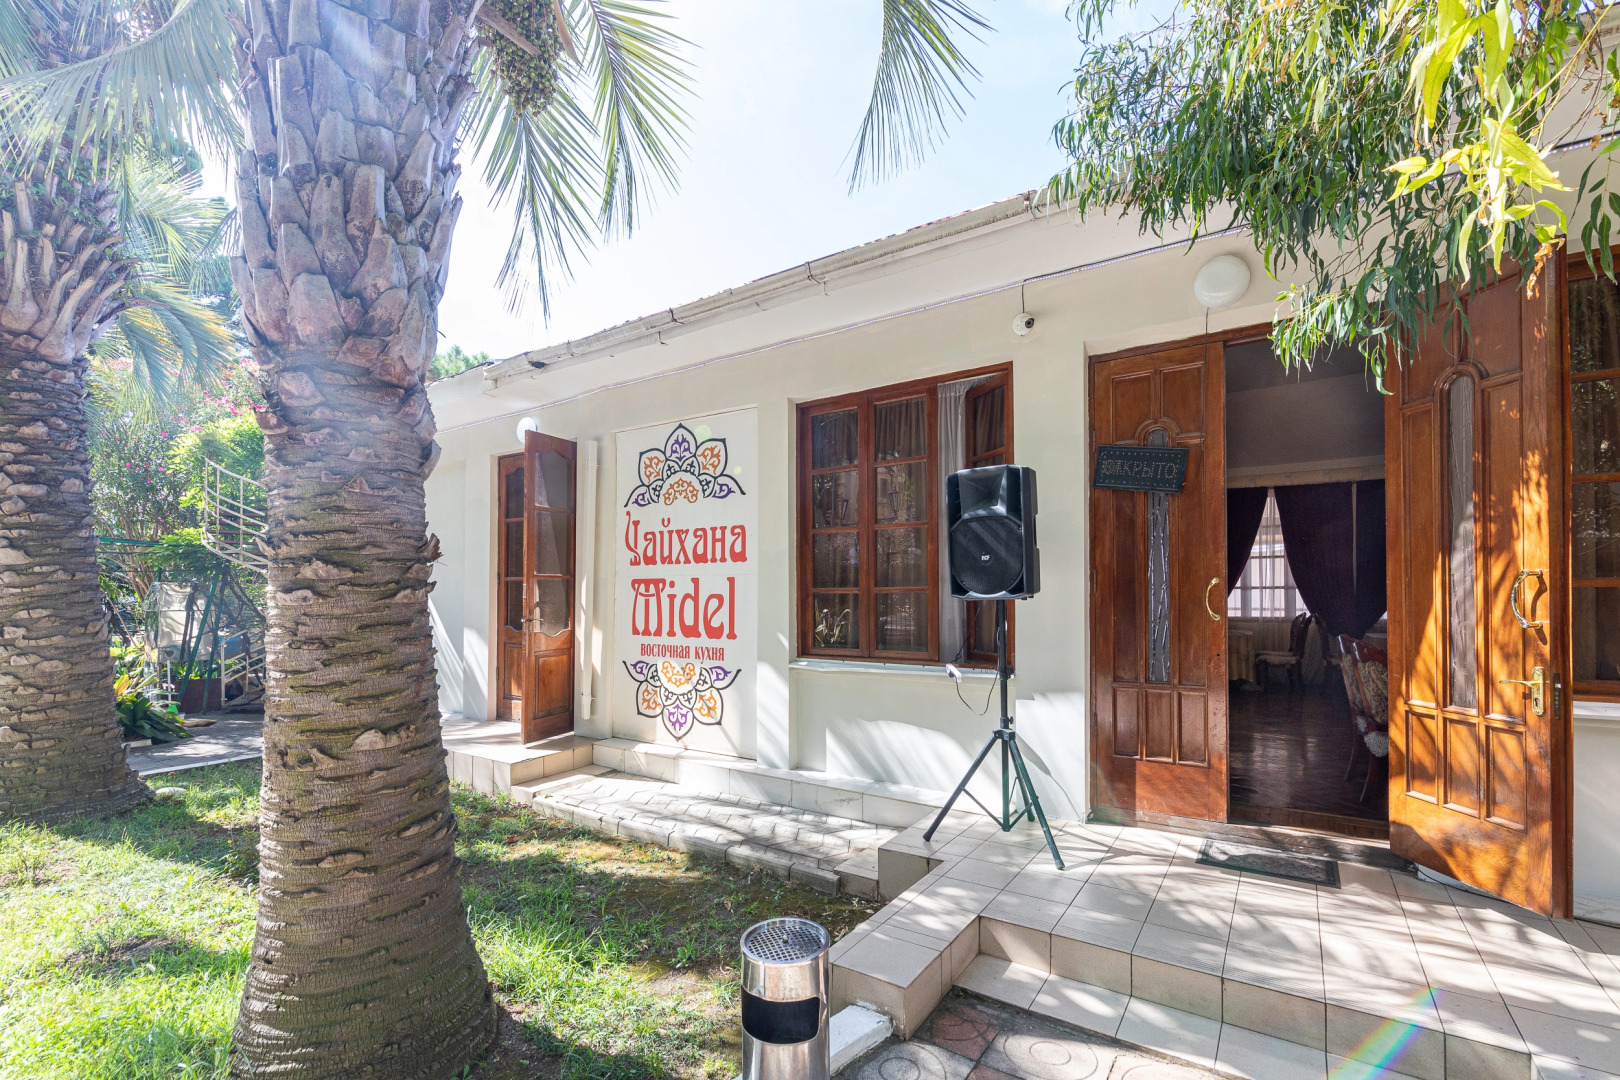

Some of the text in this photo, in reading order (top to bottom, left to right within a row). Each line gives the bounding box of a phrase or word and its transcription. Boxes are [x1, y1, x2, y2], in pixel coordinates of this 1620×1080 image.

[625, 510, 748, 567] Чайхана
[630, 576, 738, 640] Midel
[640, 643, 725, 664] восточная кухня
